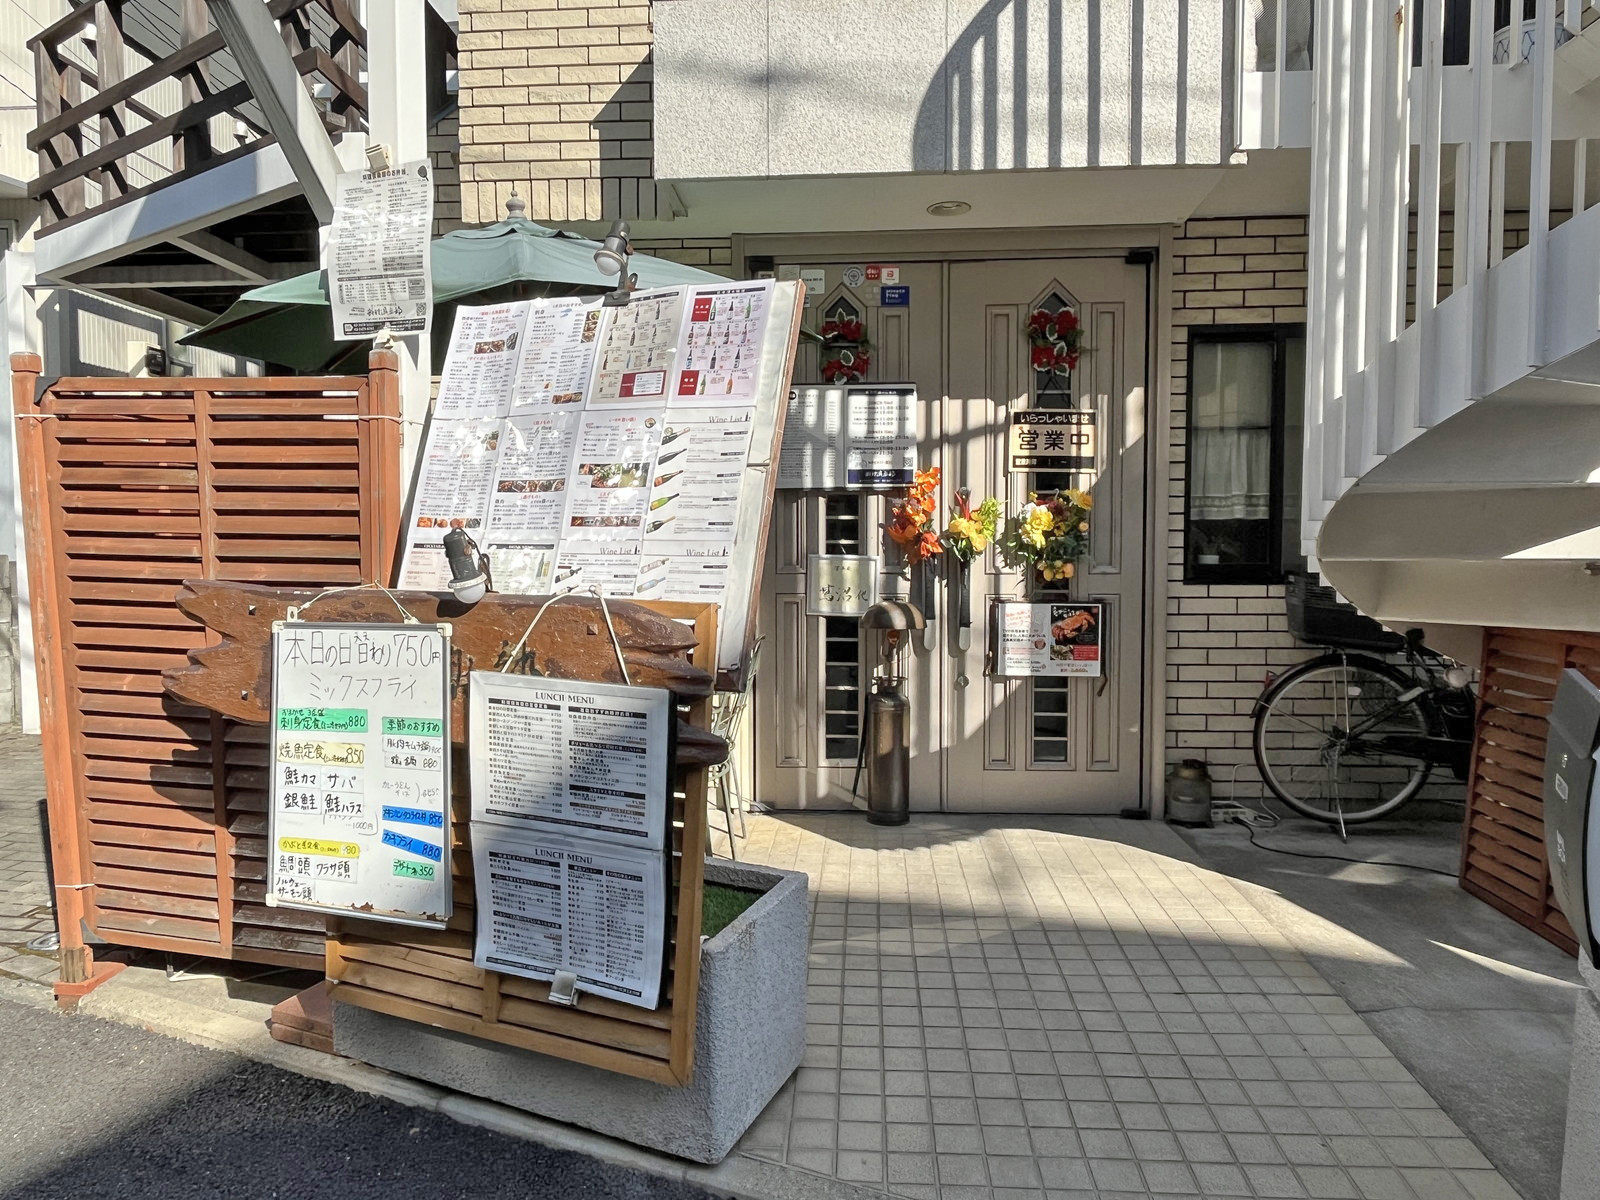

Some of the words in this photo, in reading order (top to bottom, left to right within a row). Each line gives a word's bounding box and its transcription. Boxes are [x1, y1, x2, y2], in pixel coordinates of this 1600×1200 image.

[708, 415, 728, 424] Wine
[732, 415, 743, 423] List
[1020, 413, 1090, 424] いらっしゃいませ
[1018, 429, 1090, 451] 営業中
[599, 547, 618, 556] Wine
[621, 547, 632, 555] List
[685, 548, 704, 557] Wine
[707, 548, 720, 556] List
[309, 672, 417, 701] ミックスフライ
[535, 691, 565, 702] LUNCH
[567, 694, 595, 704] MENU
[348, 715, 366, 728] 880
[386, 717, 440, 733] 季節のおすすめ
[278, 742, 325, 761] 焼魚定食
[345, 746, 365, 764] 850
[422, 757, 438, 769] 880
[283, 766, 317, 786] 鮭カマ
[326, 772, 357, 789] サバ
[283, 792, 318, 811] 銀鮭
[324, 793, 362, 815] 鮭ハラス
[422, 843, 441, 858] 880
[534, 848, 565, 860] LUNCH
[567, 853, 593, 865] MENU
[315, 860, 351, 879] ワラサ頭
[275, 877, 307, 888] ノルウェー
